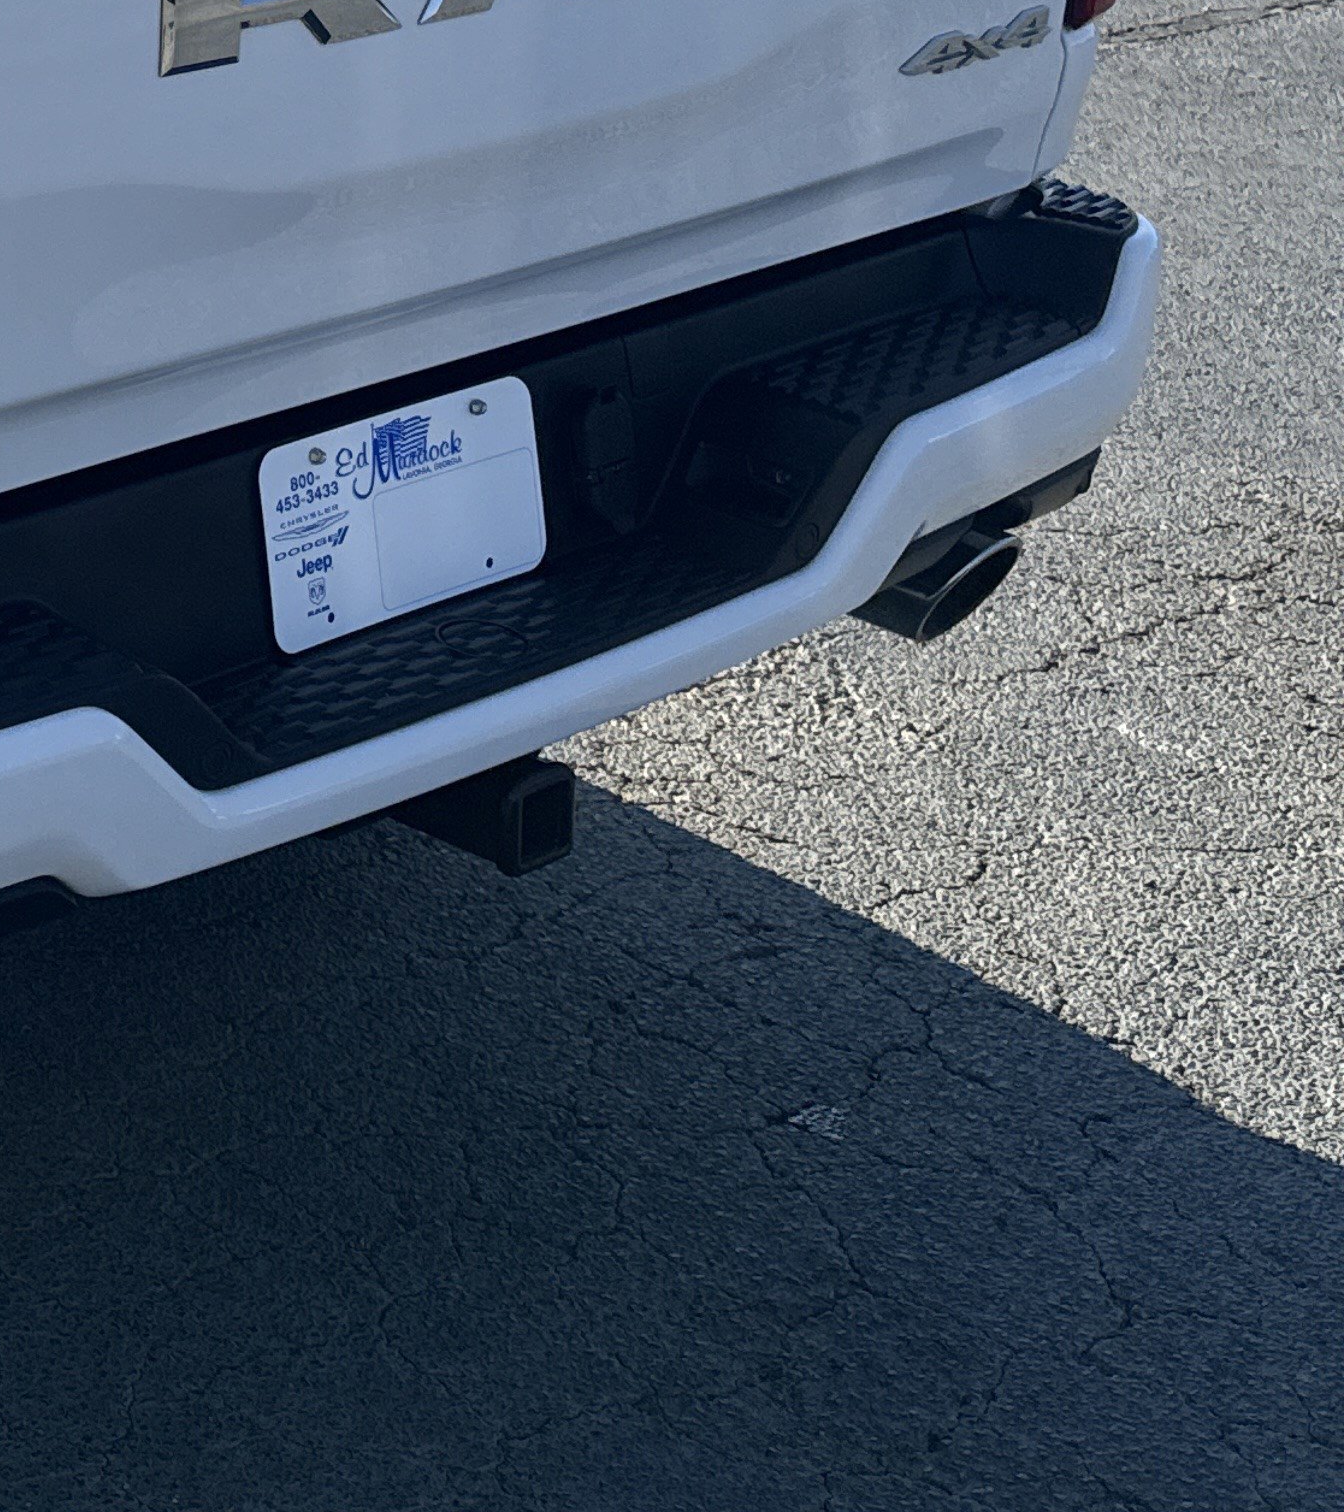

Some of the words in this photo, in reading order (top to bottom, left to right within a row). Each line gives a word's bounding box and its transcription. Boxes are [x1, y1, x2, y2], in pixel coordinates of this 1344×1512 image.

[335, 441, 369, 477] Ed
[352, 429, 463, 499] Murdock
[290, 471, 320, 491] 800-
[276, 481, 339, 514] 453-3433
[280, 504, 339, 530] CHRYSLER
[296, 554, 333, 578] Jeep
